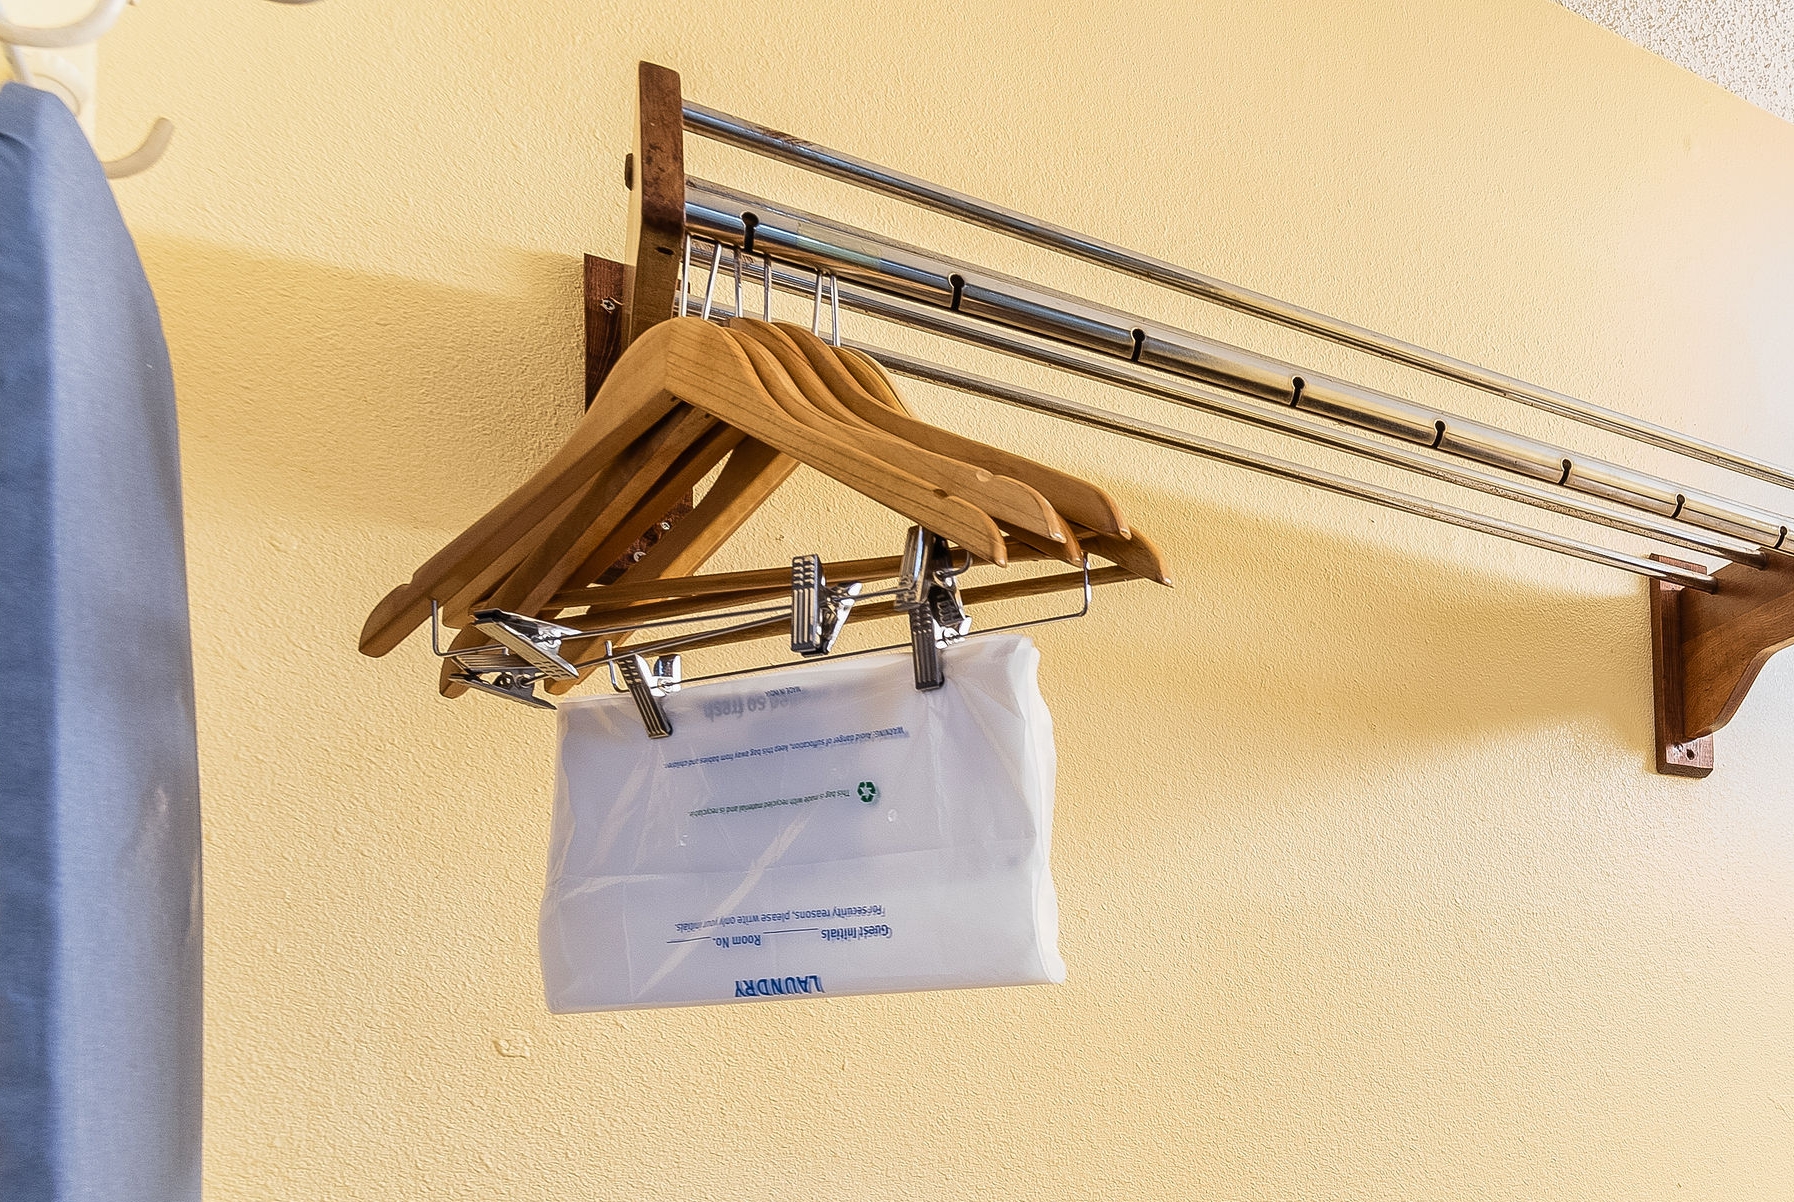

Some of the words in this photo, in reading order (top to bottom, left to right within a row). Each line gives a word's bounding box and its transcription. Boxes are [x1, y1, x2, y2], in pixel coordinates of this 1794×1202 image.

[720, 753, 733, 762] from
[750, 748, 761, 757] bag
[762, 747, 773, 756] this
[719, 915, 736, 927] only
[738, 914, 759, 926] write
[761, 911, 790, 925] please
[792, 909, 831, 923] reasons,
[821, 927, 857, 941] Initials
[859, 925, 891, 939] Guest
[712, 936, 729, 949] No.
[732, 934, 761, 948] Room
[734, 975, 823, 998] LAUNDRY
